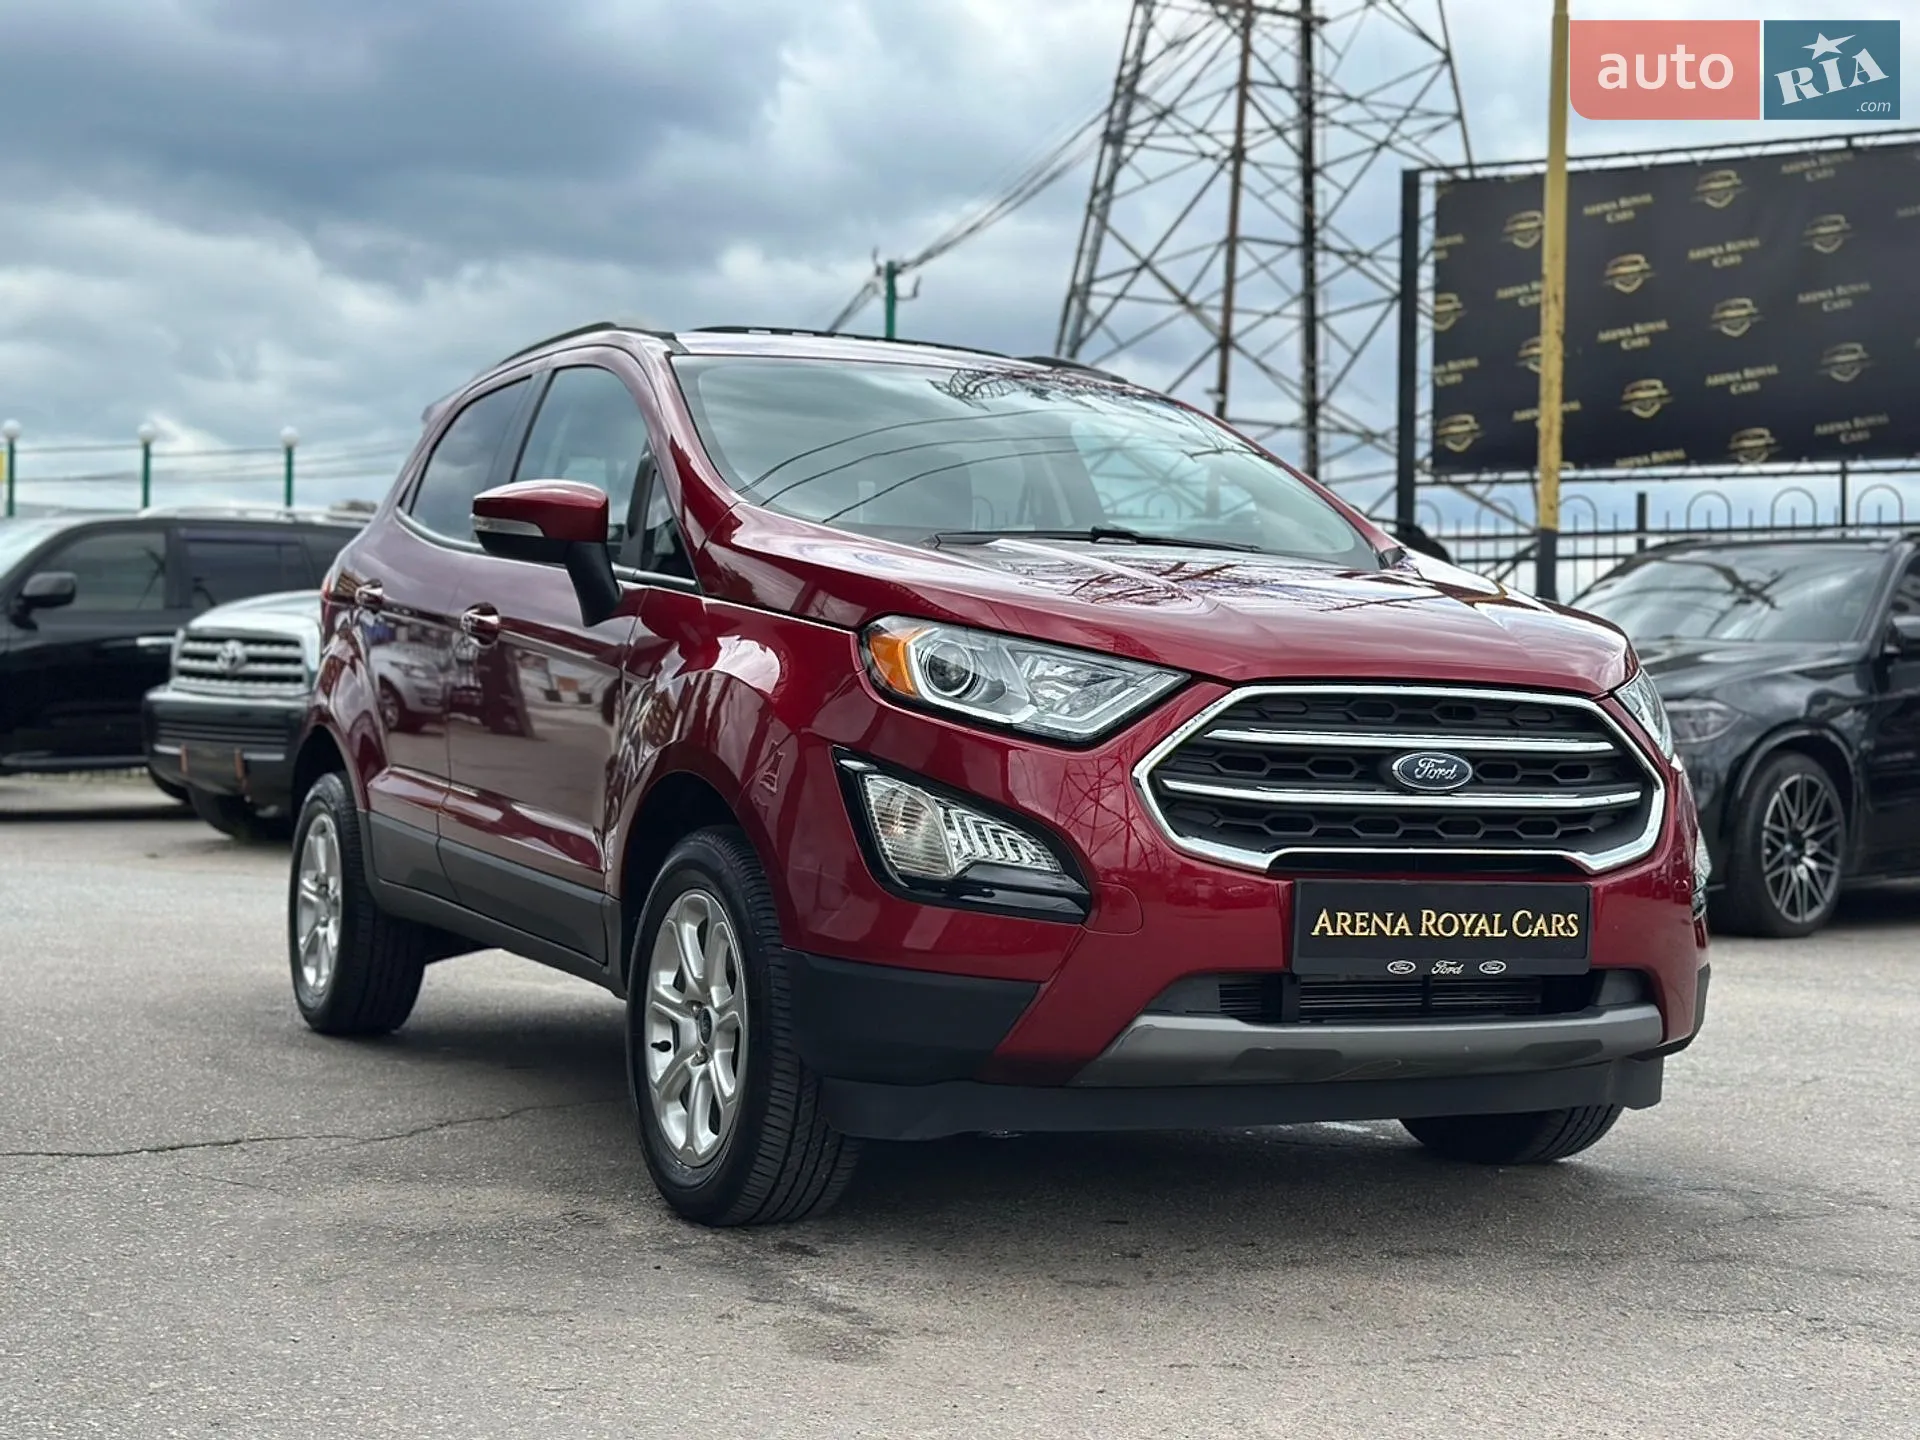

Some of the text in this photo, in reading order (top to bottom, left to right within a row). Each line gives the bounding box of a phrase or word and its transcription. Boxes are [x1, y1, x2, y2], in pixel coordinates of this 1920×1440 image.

[1414, 757, 1458, 780] Ford
[1311, 908, 1579, 938] ARENA ROYAL CARS
[1431, 960, 1464, 975] Ford
